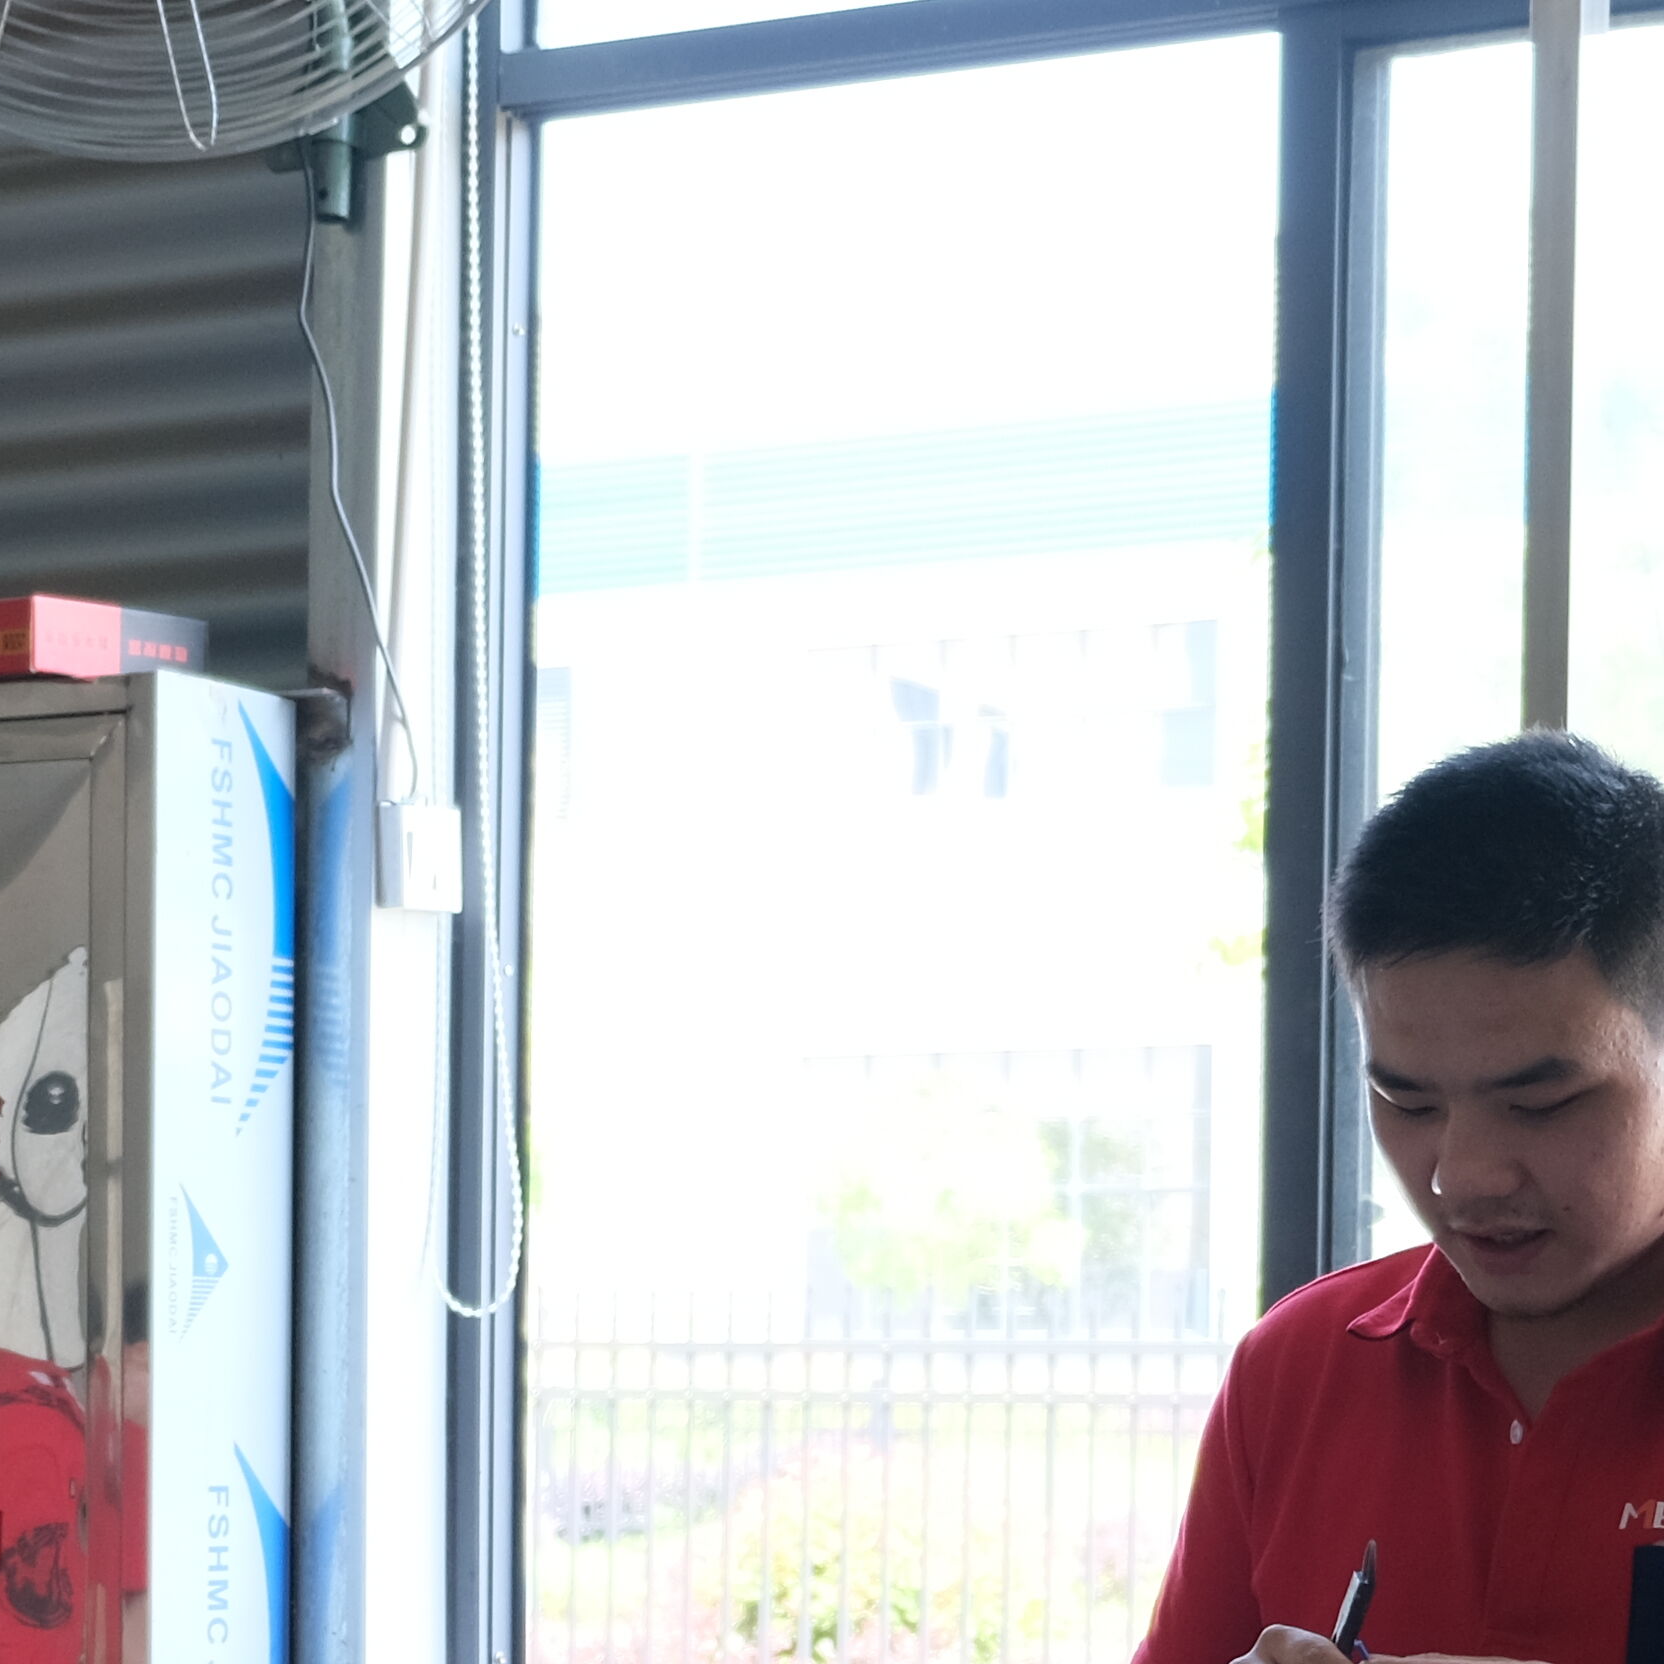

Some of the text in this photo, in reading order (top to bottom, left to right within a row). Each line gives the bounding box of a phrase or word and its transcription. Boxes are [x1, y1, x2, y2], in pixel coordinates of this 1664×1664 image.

[209, 737, 233, 1105] FSHMC JIAODAI
[208, 1485, 228, 1650] FSHMC
